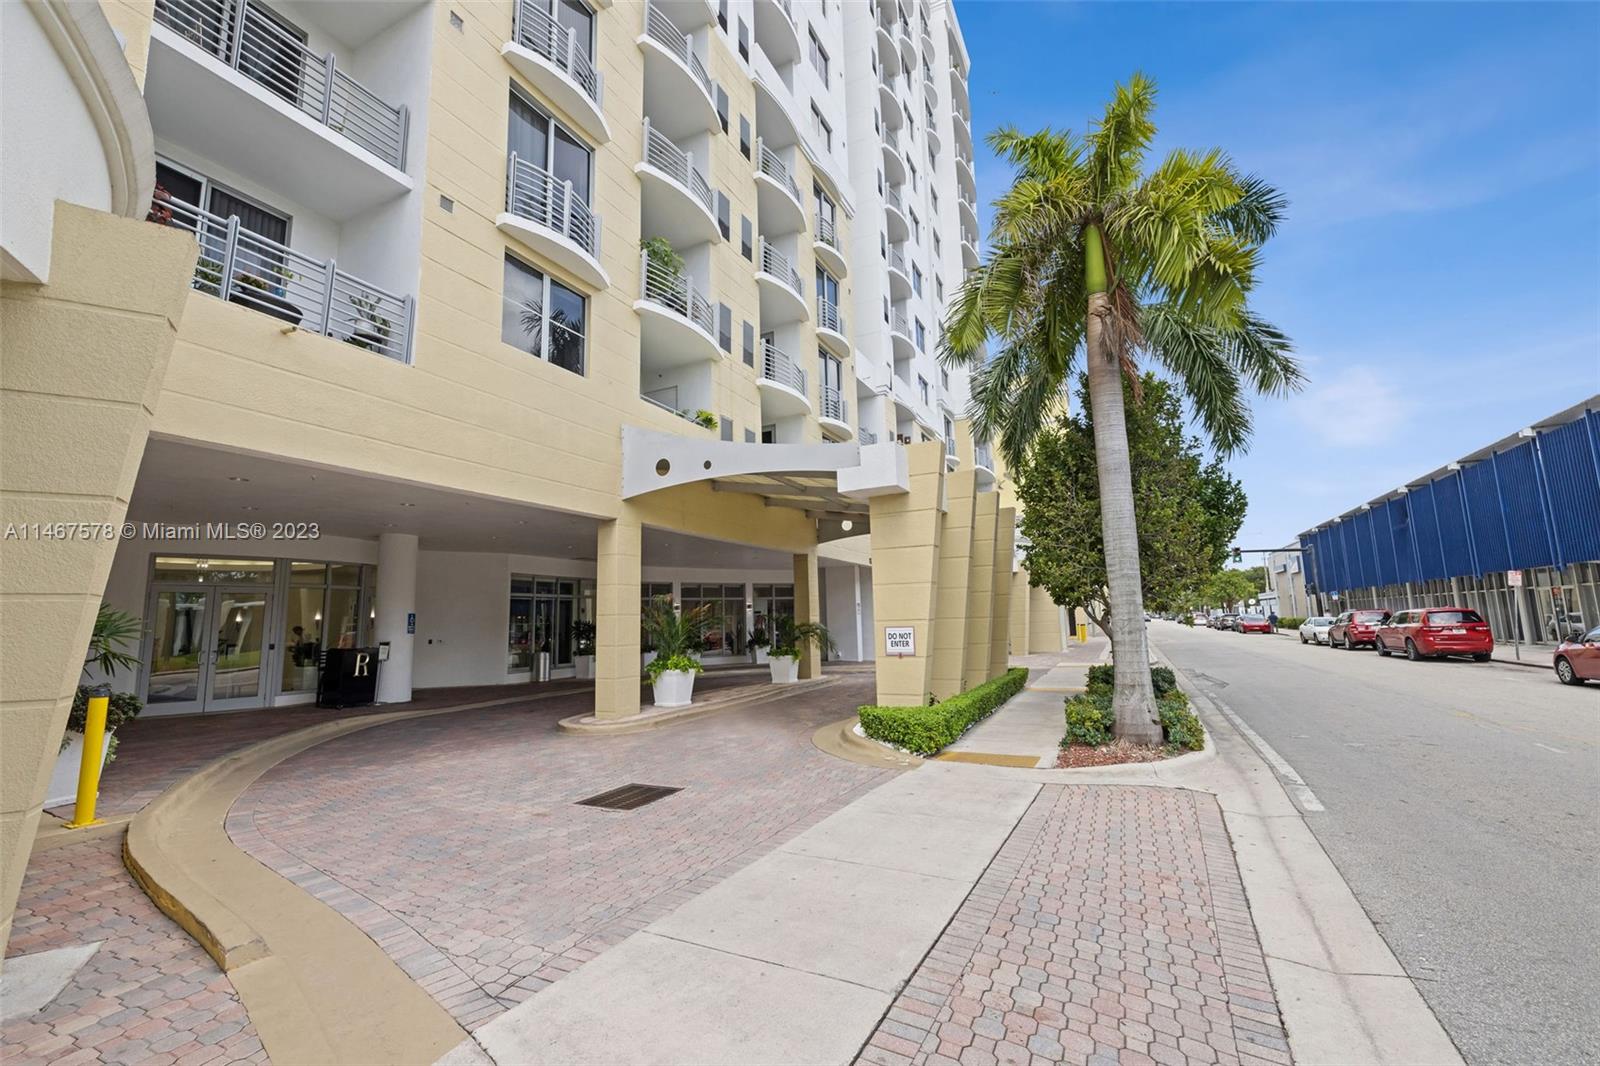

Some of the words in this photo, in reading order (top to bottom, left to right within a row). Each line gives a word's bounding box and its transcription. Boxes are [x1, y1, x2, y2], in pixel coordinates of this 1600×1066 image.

[888, 632, 898, 640] DO
[898, 632, 912, 640] NOT
[890, 640, 910, 648] ENTER
[353, 652, 370, 677] R
